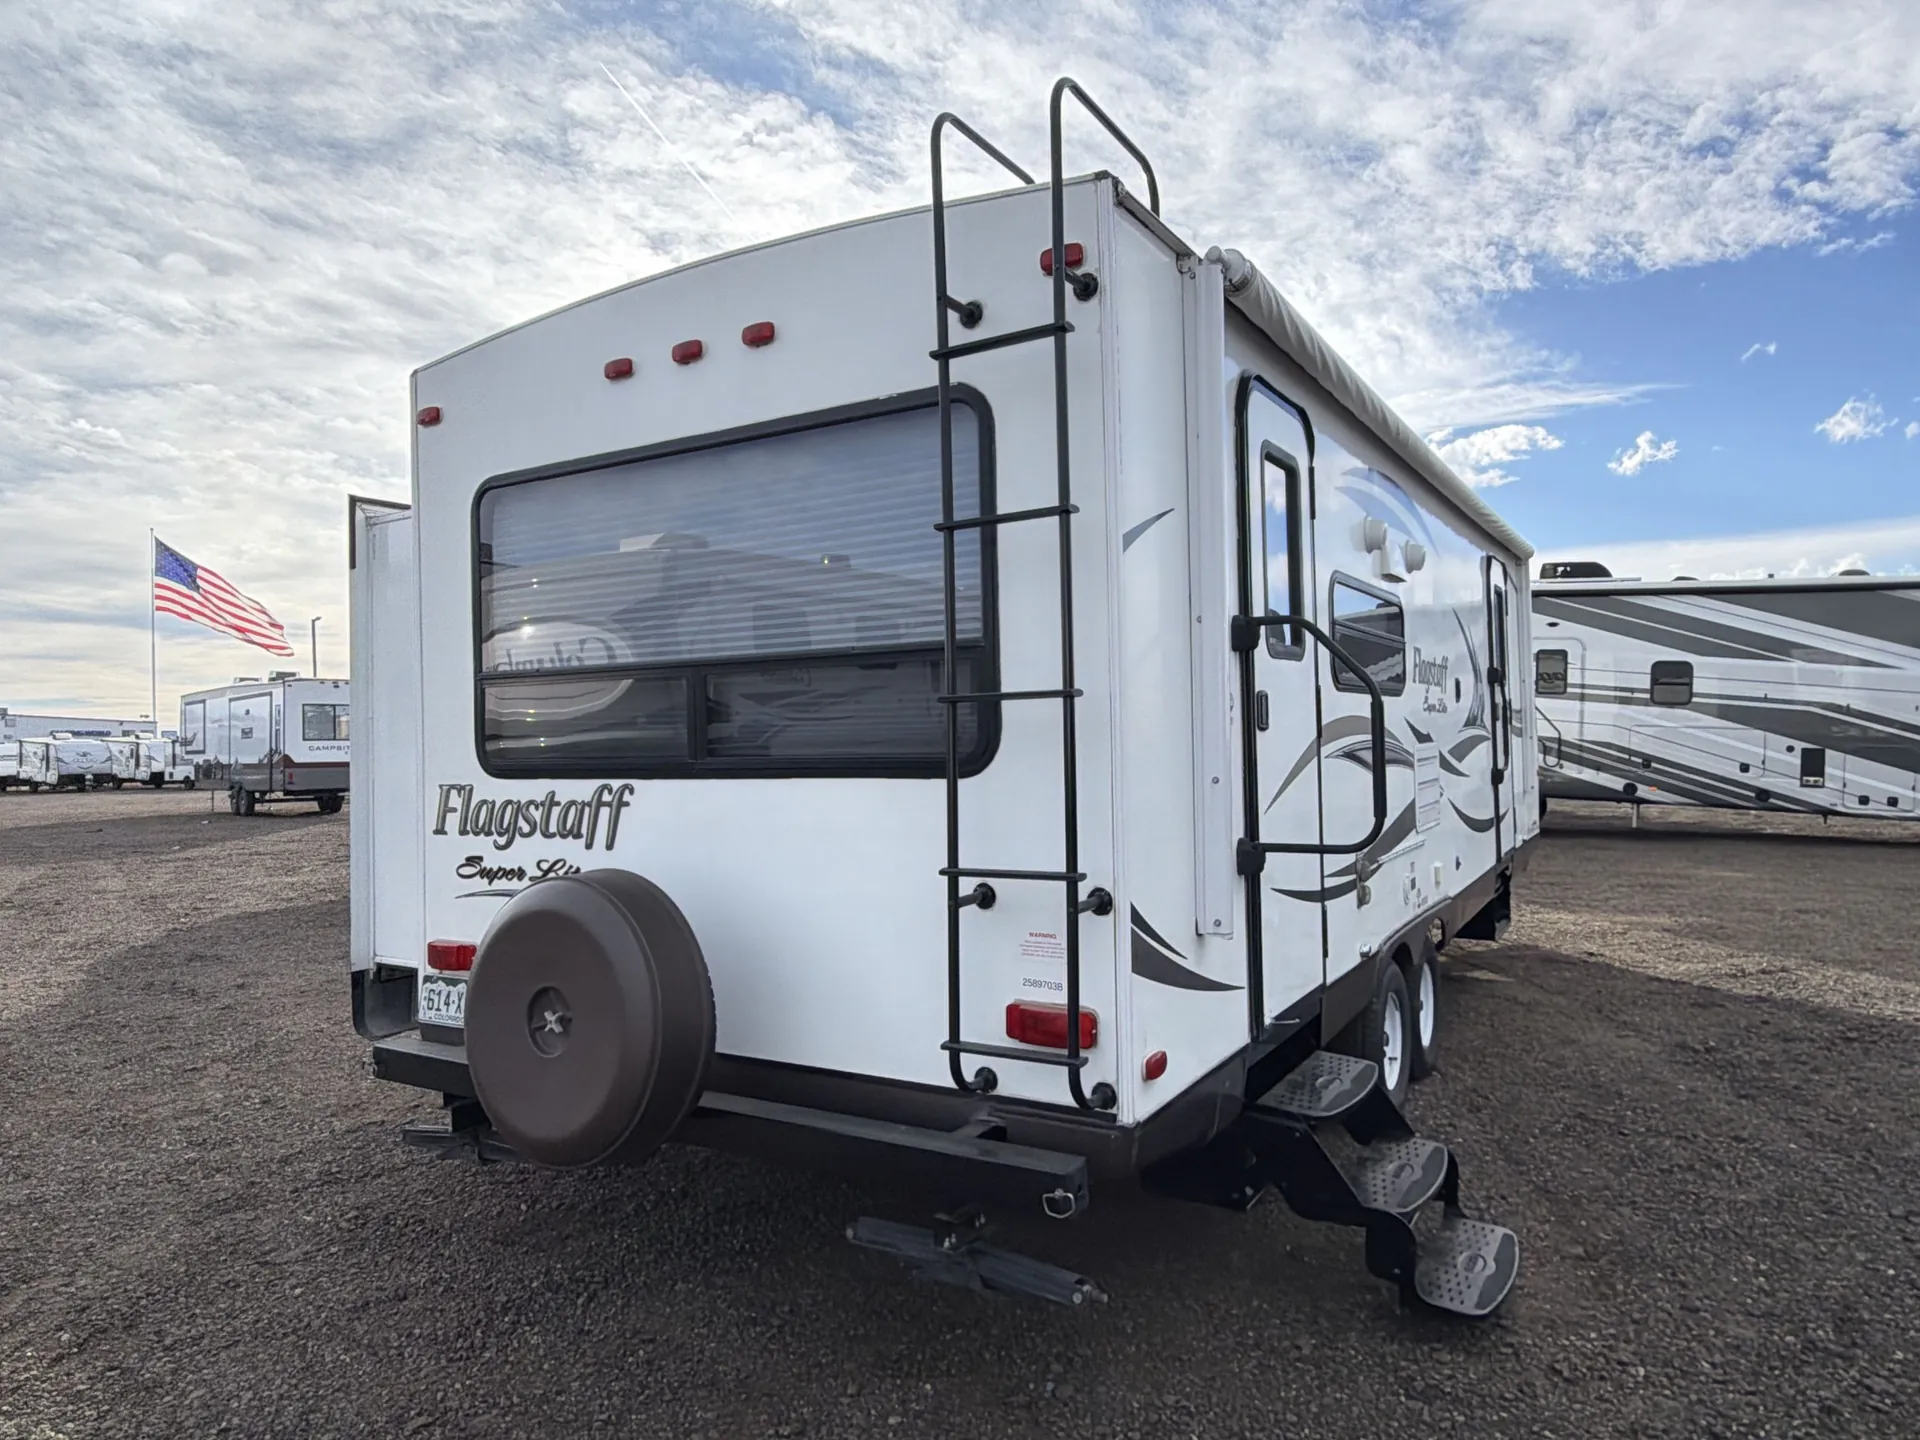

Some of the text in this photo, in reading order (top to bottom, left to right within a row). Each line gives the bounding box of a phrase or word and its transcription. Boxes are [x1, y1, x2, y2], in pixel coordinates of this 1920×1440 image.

[1412, 646, 1449, 694] Flagstaff
[433, 783, 634, 850] Flagstaff
[455, 855, 581, 886] Super Li
[1028, 931, 1057, 940] WARNING
[1022, 977, 1064, 991] 2589703B
